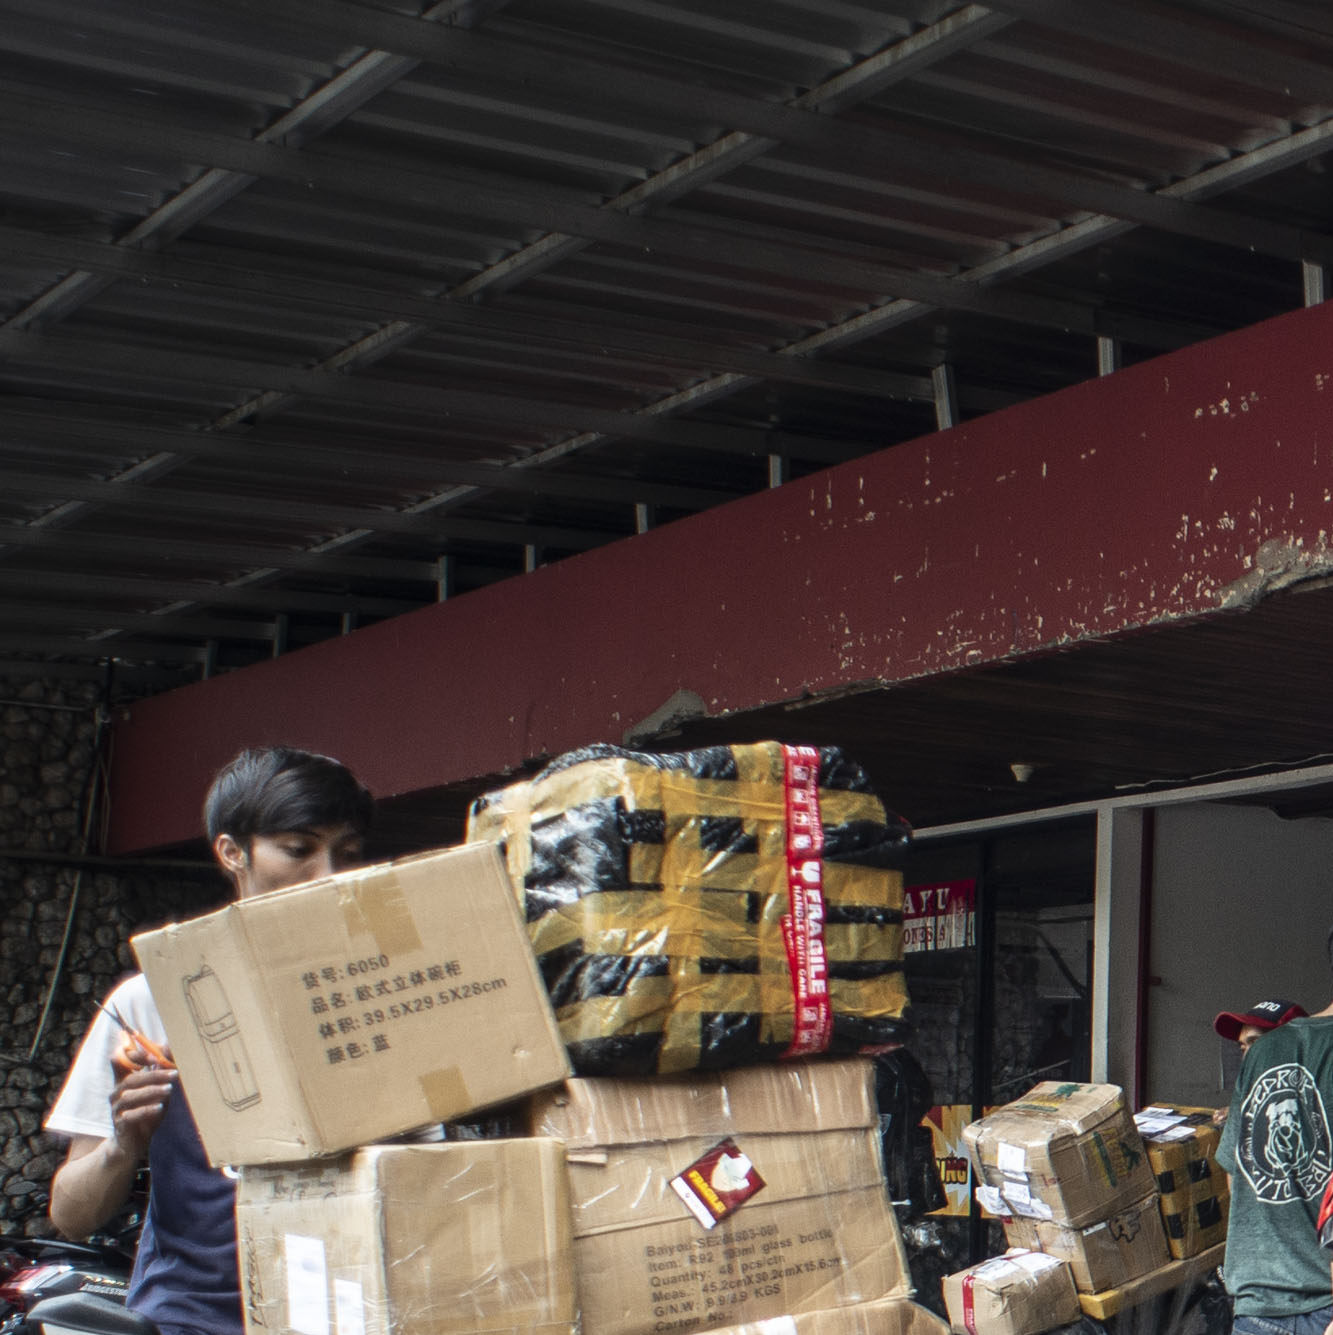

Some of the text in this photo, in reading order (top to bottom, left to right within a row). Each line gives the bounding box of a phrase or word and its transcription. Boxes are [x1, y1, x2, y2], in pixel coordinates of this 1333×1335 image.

[806, 889, 828, 994] FRAGILE
[347, 954, 390, 977] 6050
[761, 1238, 793, 1254] glass
[798, 1227, 834, 1245] bottle
[651, 1268, 713, 1288] Quantity:
[655, 1317, 700, 1334] Carton
